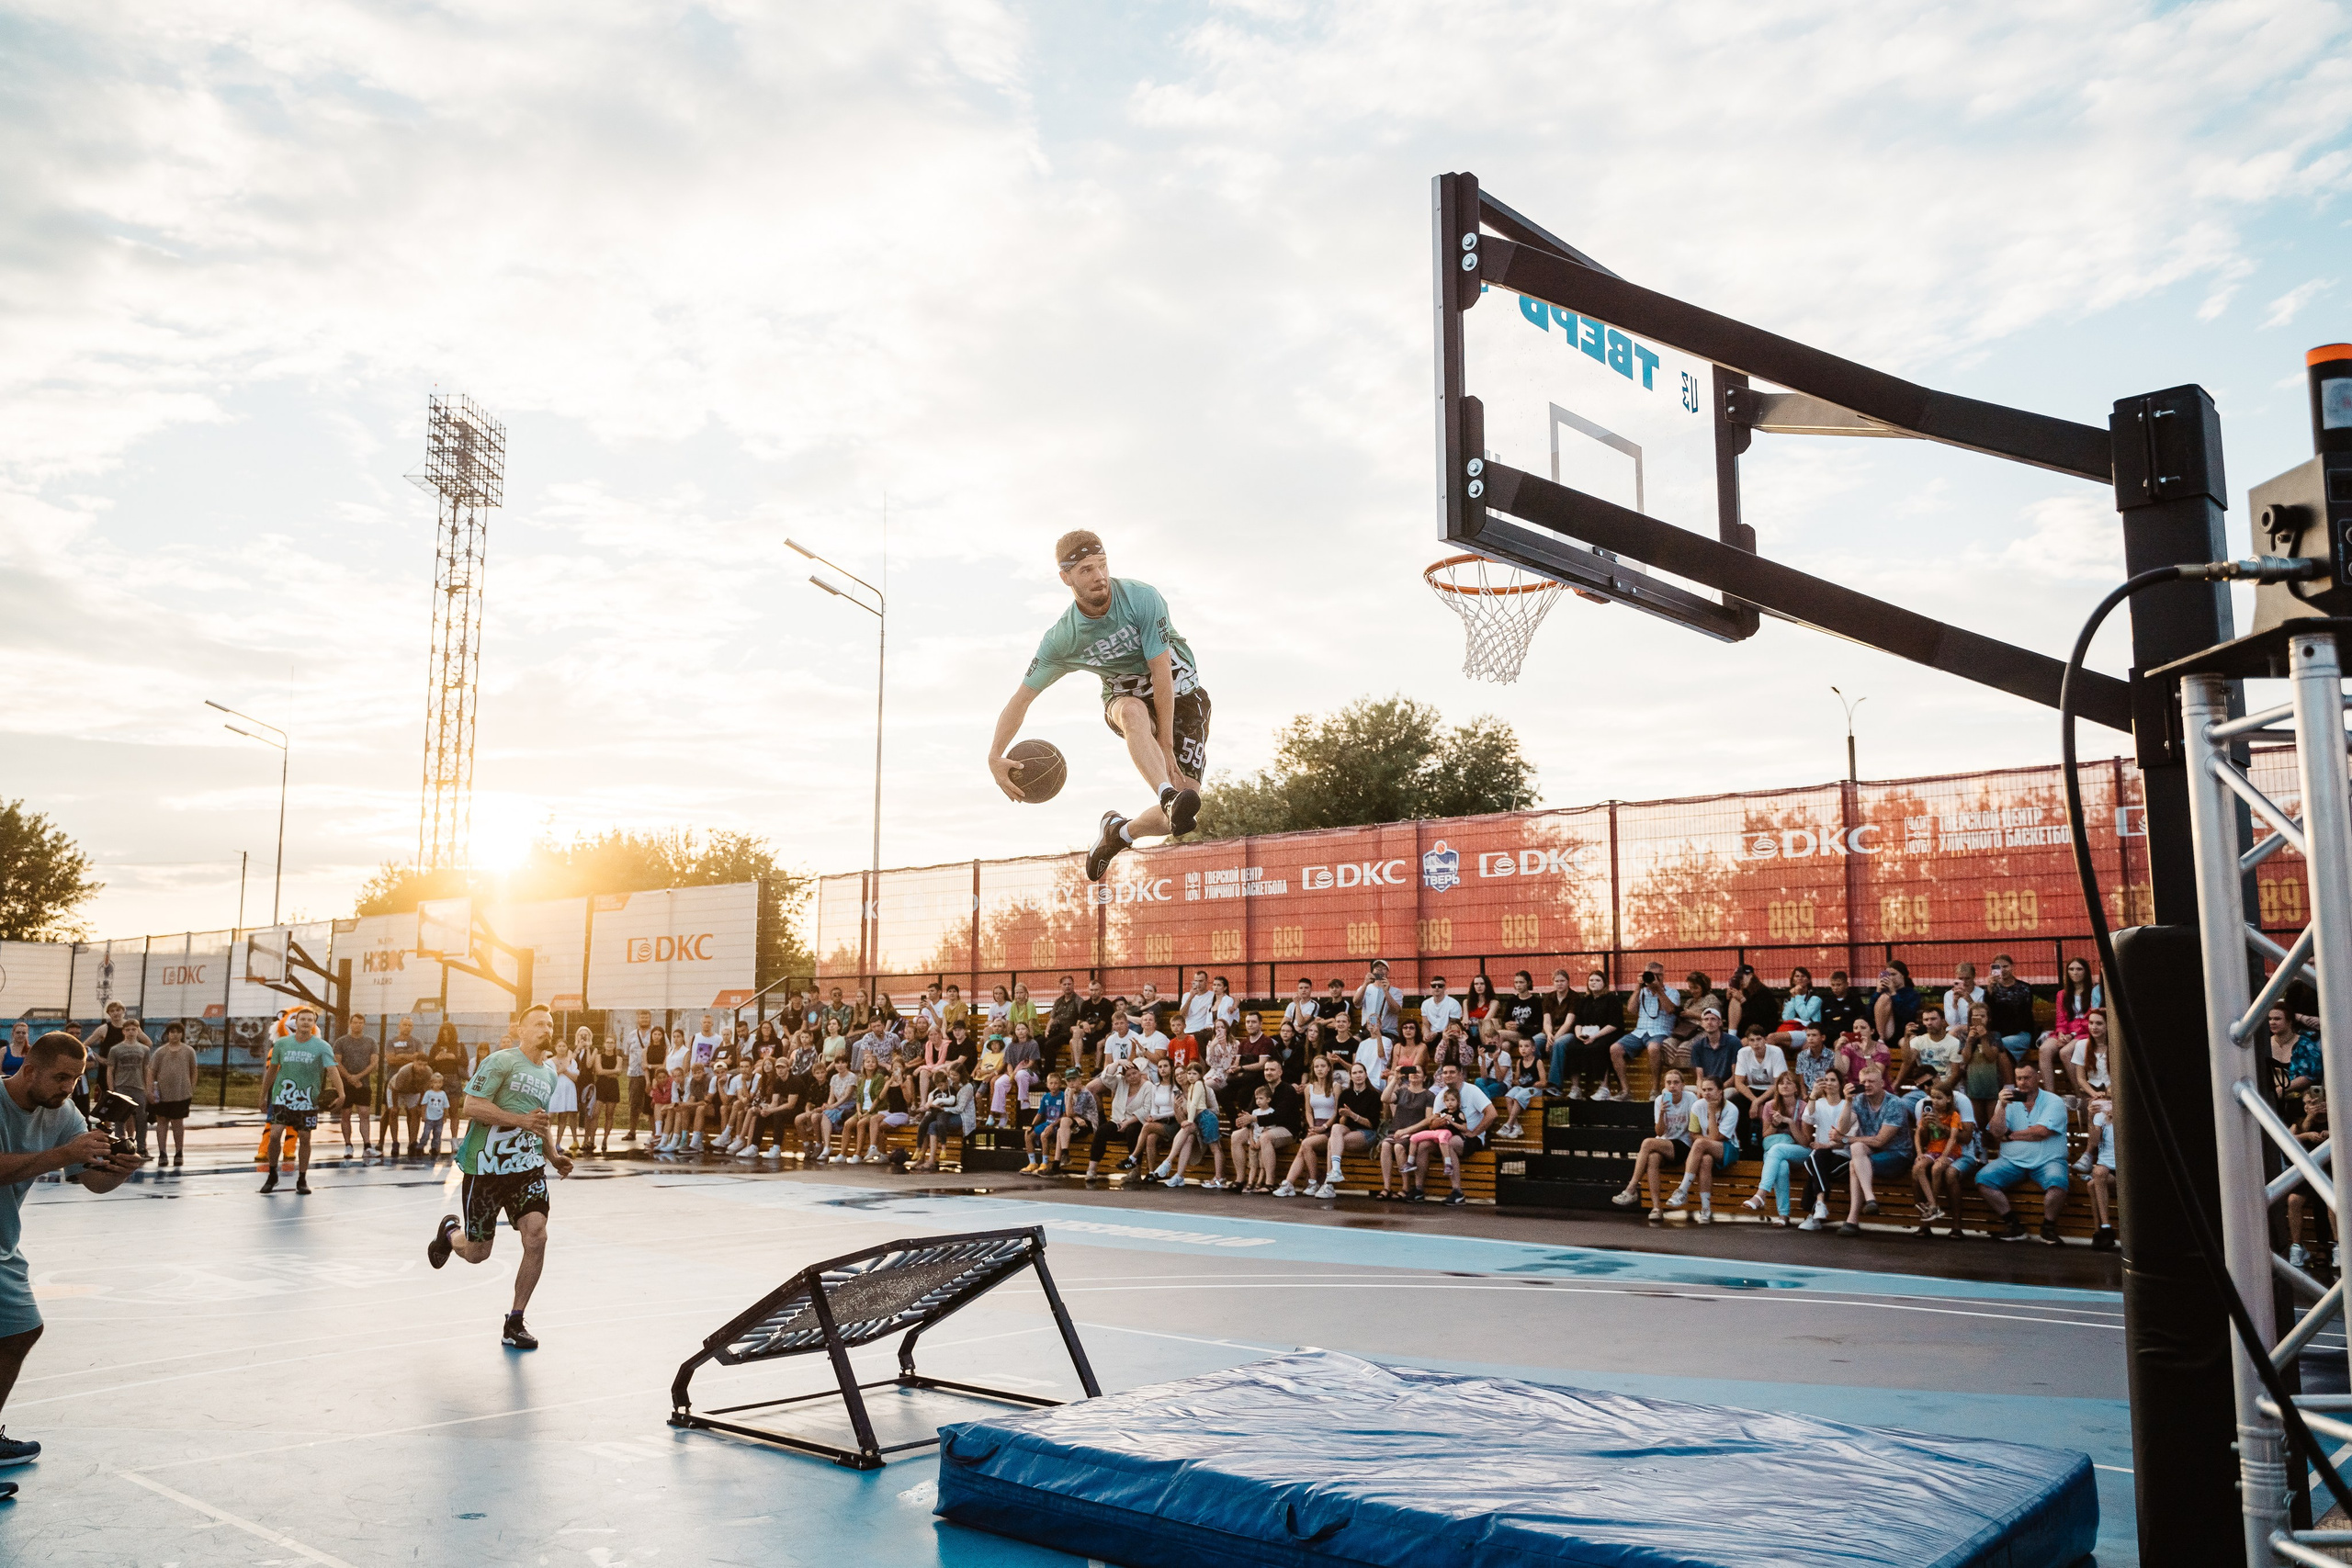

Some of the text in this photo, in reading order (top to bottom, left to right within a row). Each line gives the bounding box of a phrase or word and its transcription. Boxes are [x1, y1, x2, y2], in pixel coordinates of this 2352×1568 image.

[1179, 737, 1204, 769] 59
[1939, 807, 2042, 832] ТВЕРСКОЙ ЦЕНТР
[1782, 825, 1882, 858] DKC
[1939, 825, 2087, 852] УЛИЧНОГО БАСКЕТБО
[1204, 865, 1239, 885] ТВЕРСКОЙ
[1240, 866, 1263, 883] ЦЕНТР
[1338, 860, 1406, 888] DKC
[1519, 845, 1600, 875] DKC
[1115, 878, 1172, 904] DKC
[1204, 879, 1287, 899] УЛИЧНОГО БАСКЕТБОЛА
[1423, 874, 1460, 886] ТВЕРЬ
[1985, 889, 2038, 931] 889
[2259, 876, 2301, 922] 89
[1769, 899, 1815, 940] 889
[1881, 895, 1929, 935] 889
[1212, 929, 1240, 962] 889
[1273, 925, 1304, 958] 889
[1347, 921, 1380, 954] 889
[1419, 918, 1453, 952] 889
[1501, 913, 1539, 949] 889
[655, 933, 714, 962] DKC
[1146, 933, 1172, 963] 889
[176, 964, 206, 985] DKC
[510, 1081, 551, 1103] БАСКЕ
[305, 1116, 318, 1127] 59
